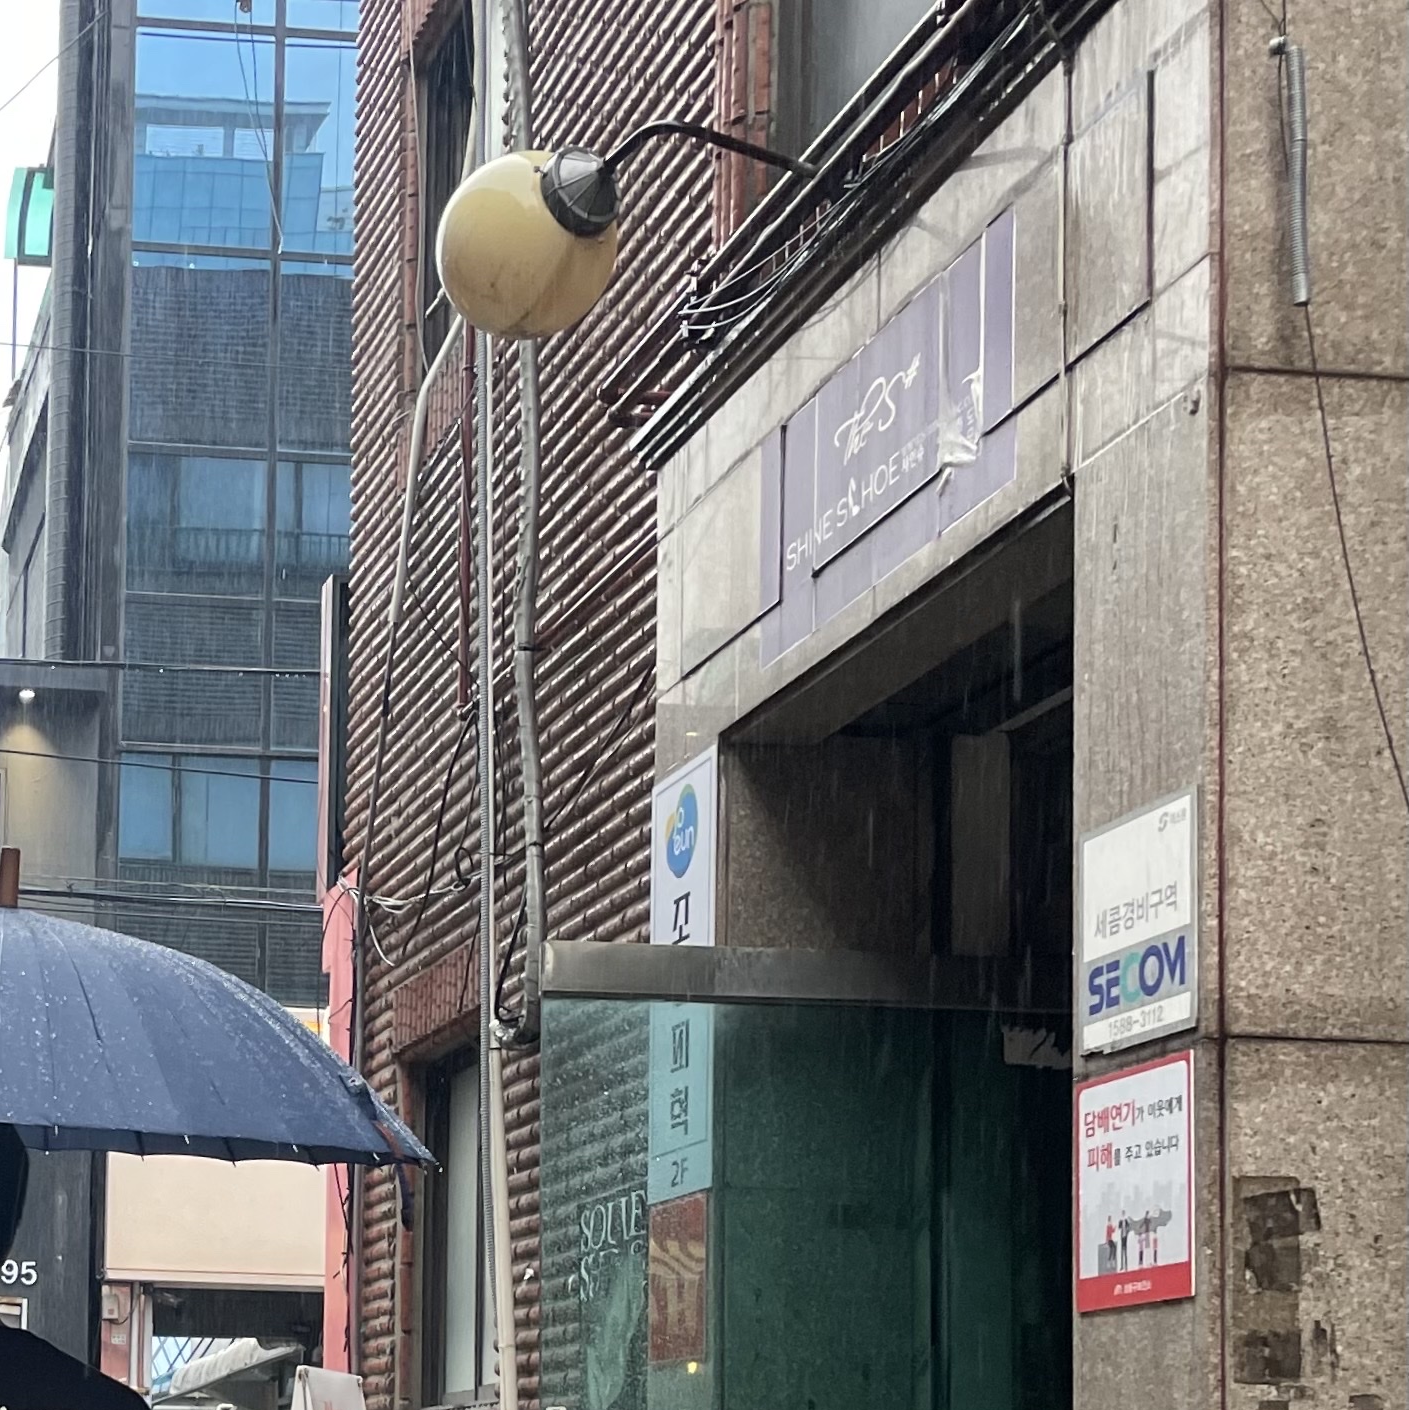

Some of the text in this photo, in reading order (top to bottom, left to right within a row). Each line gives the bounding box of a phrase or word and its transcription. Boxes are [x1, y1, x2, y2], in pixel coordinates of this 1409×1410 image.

[1093, 881, 1178, 939] 세콤경비구역
[1089, 935, 1185, 1016] SECOM
[1108, 1005, 1164, 1038] 1588-3112
[1084, 1099, 1144, 1138] 담배연기가
[670, 1158, 689, 1187] 2F
[1087, 1135, 1180, 1172] 피해를 주고 있습니다
